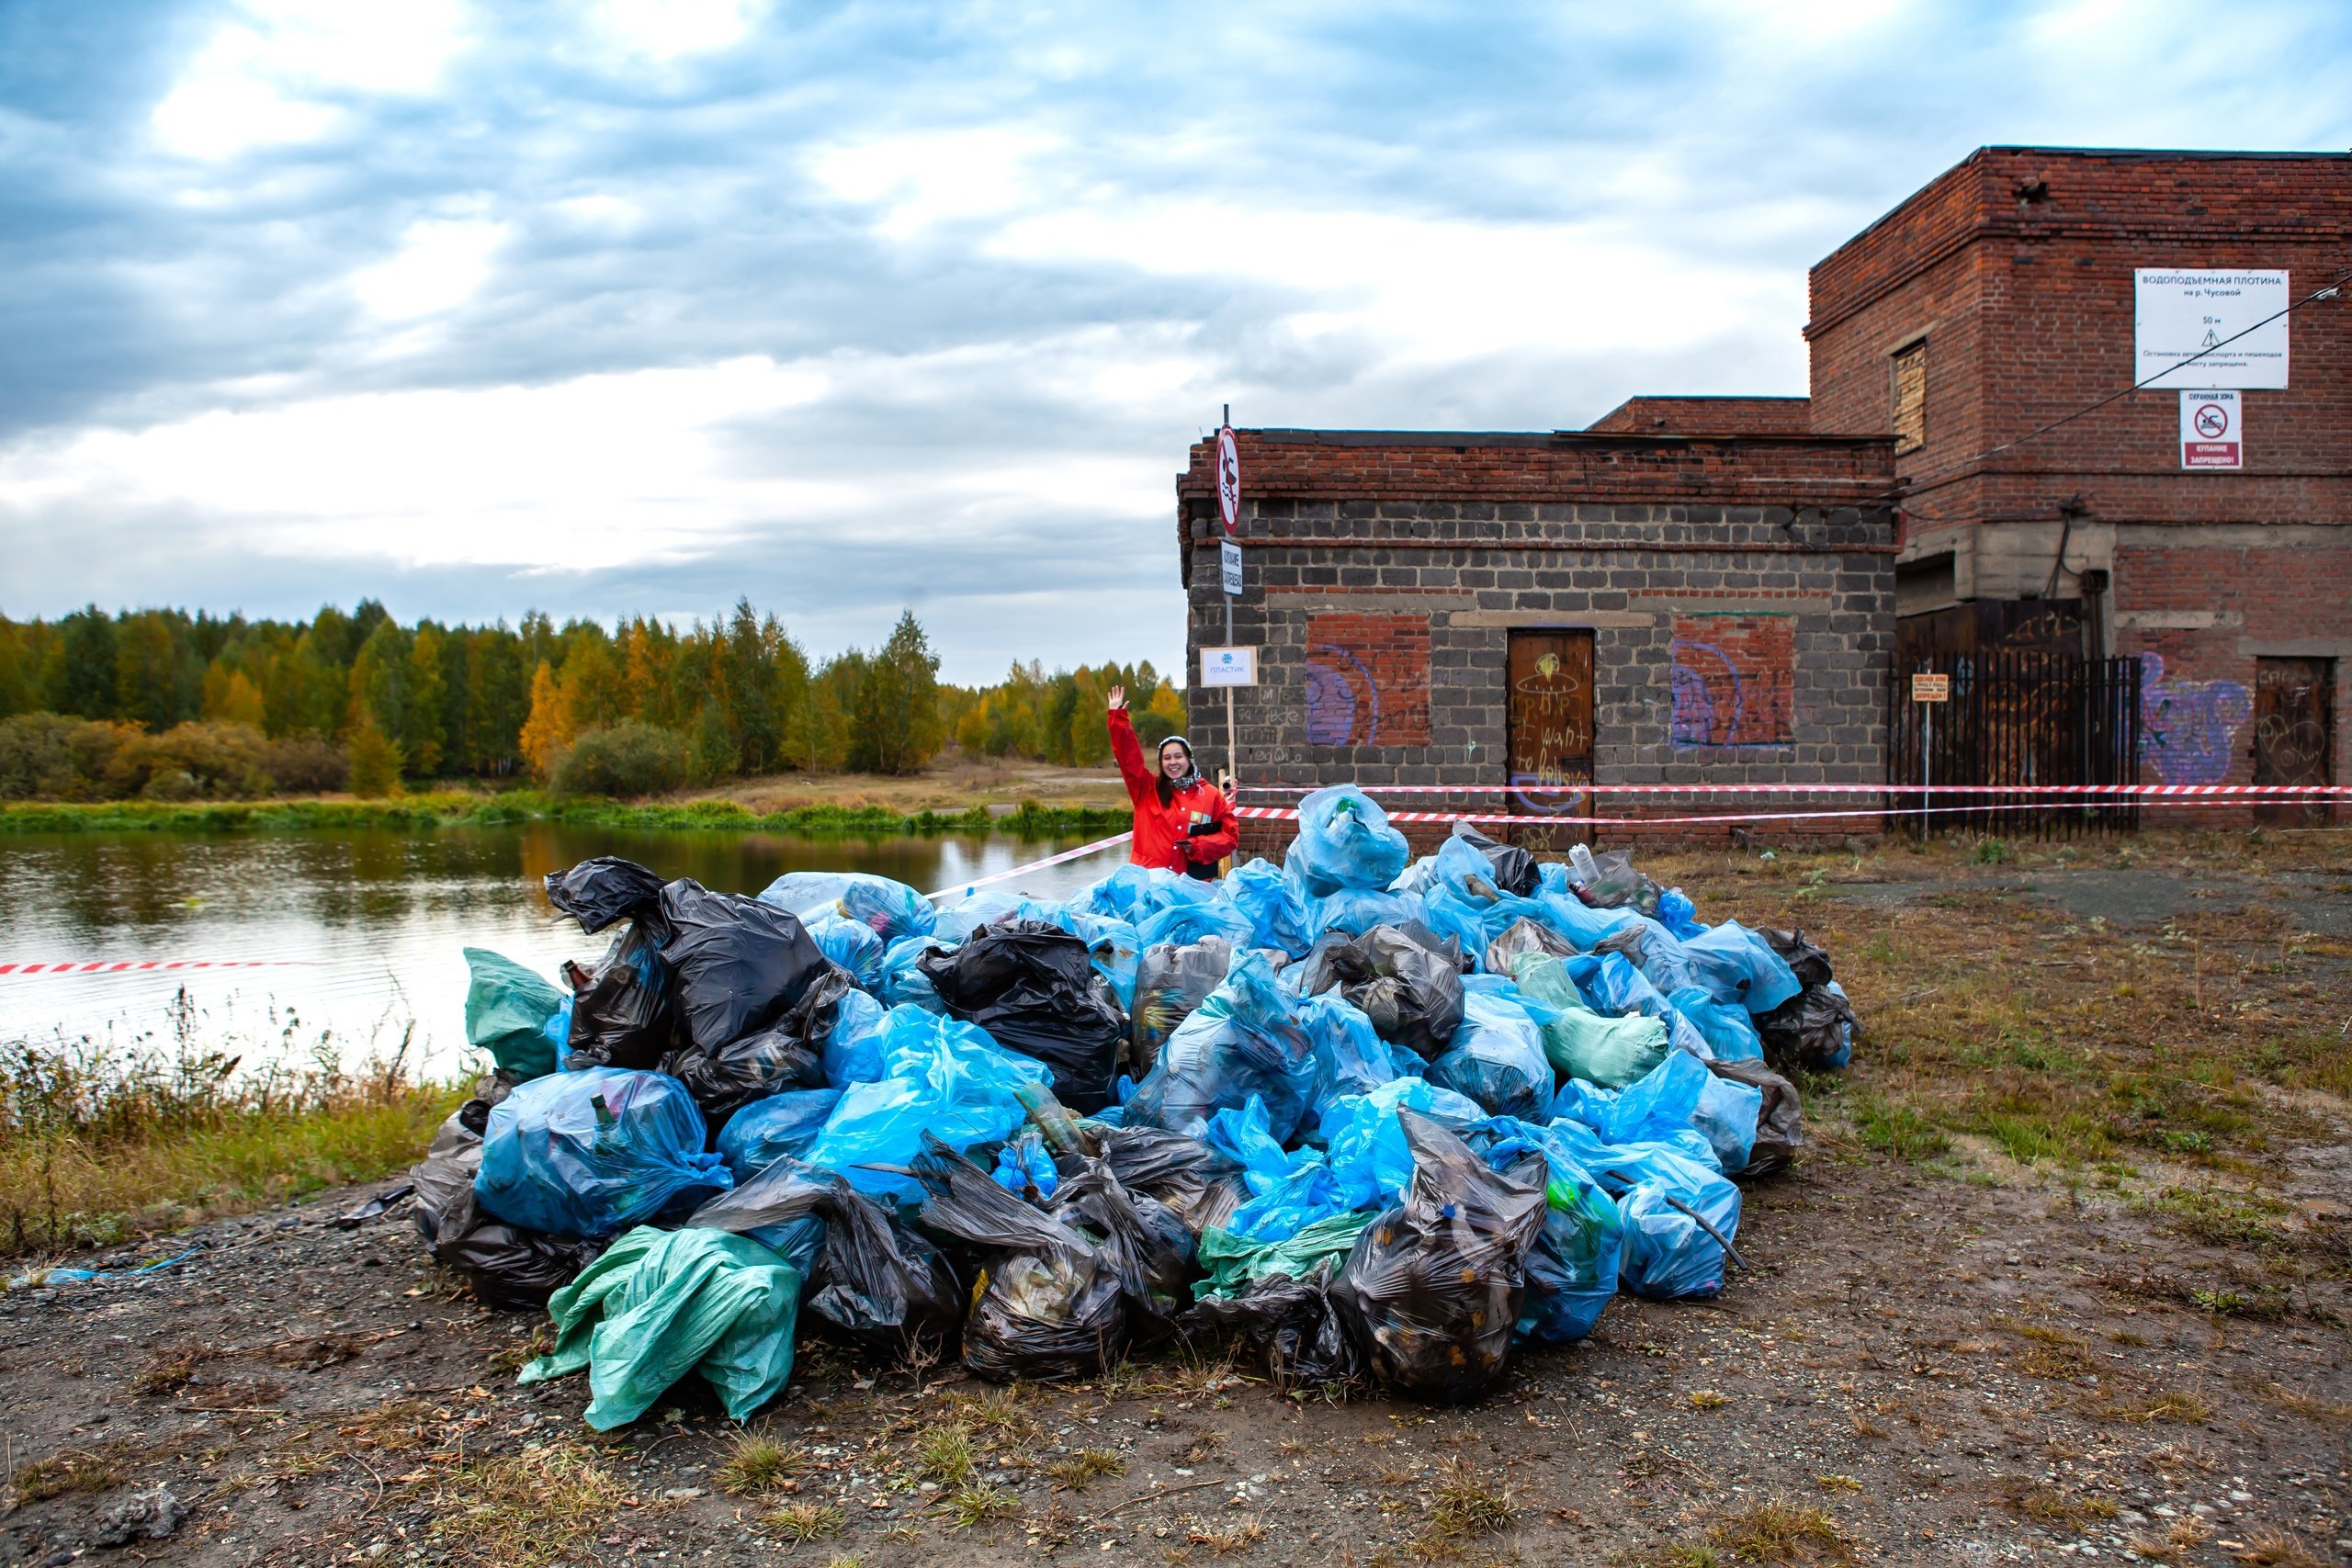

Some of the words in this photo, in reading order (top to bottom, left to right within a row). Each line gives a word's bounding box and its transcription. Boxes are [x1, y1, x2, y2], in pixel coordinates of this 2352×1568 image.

[2143, 276, 2232, 286] ВОДОПОДЪЕМНАЯ
[2234, 276, 2282, 286] ПЛОТИНА
[2205, 288, 2241, 298] Чусовой
[2203, 316, 2213, 325] 50
[2196, 445, 2228, 453] КУПАНИЕ
[1516, 716, 1536, 742] I
[1541, 720, 1589, 751] want
[1516, 745, 1533, 773] to
